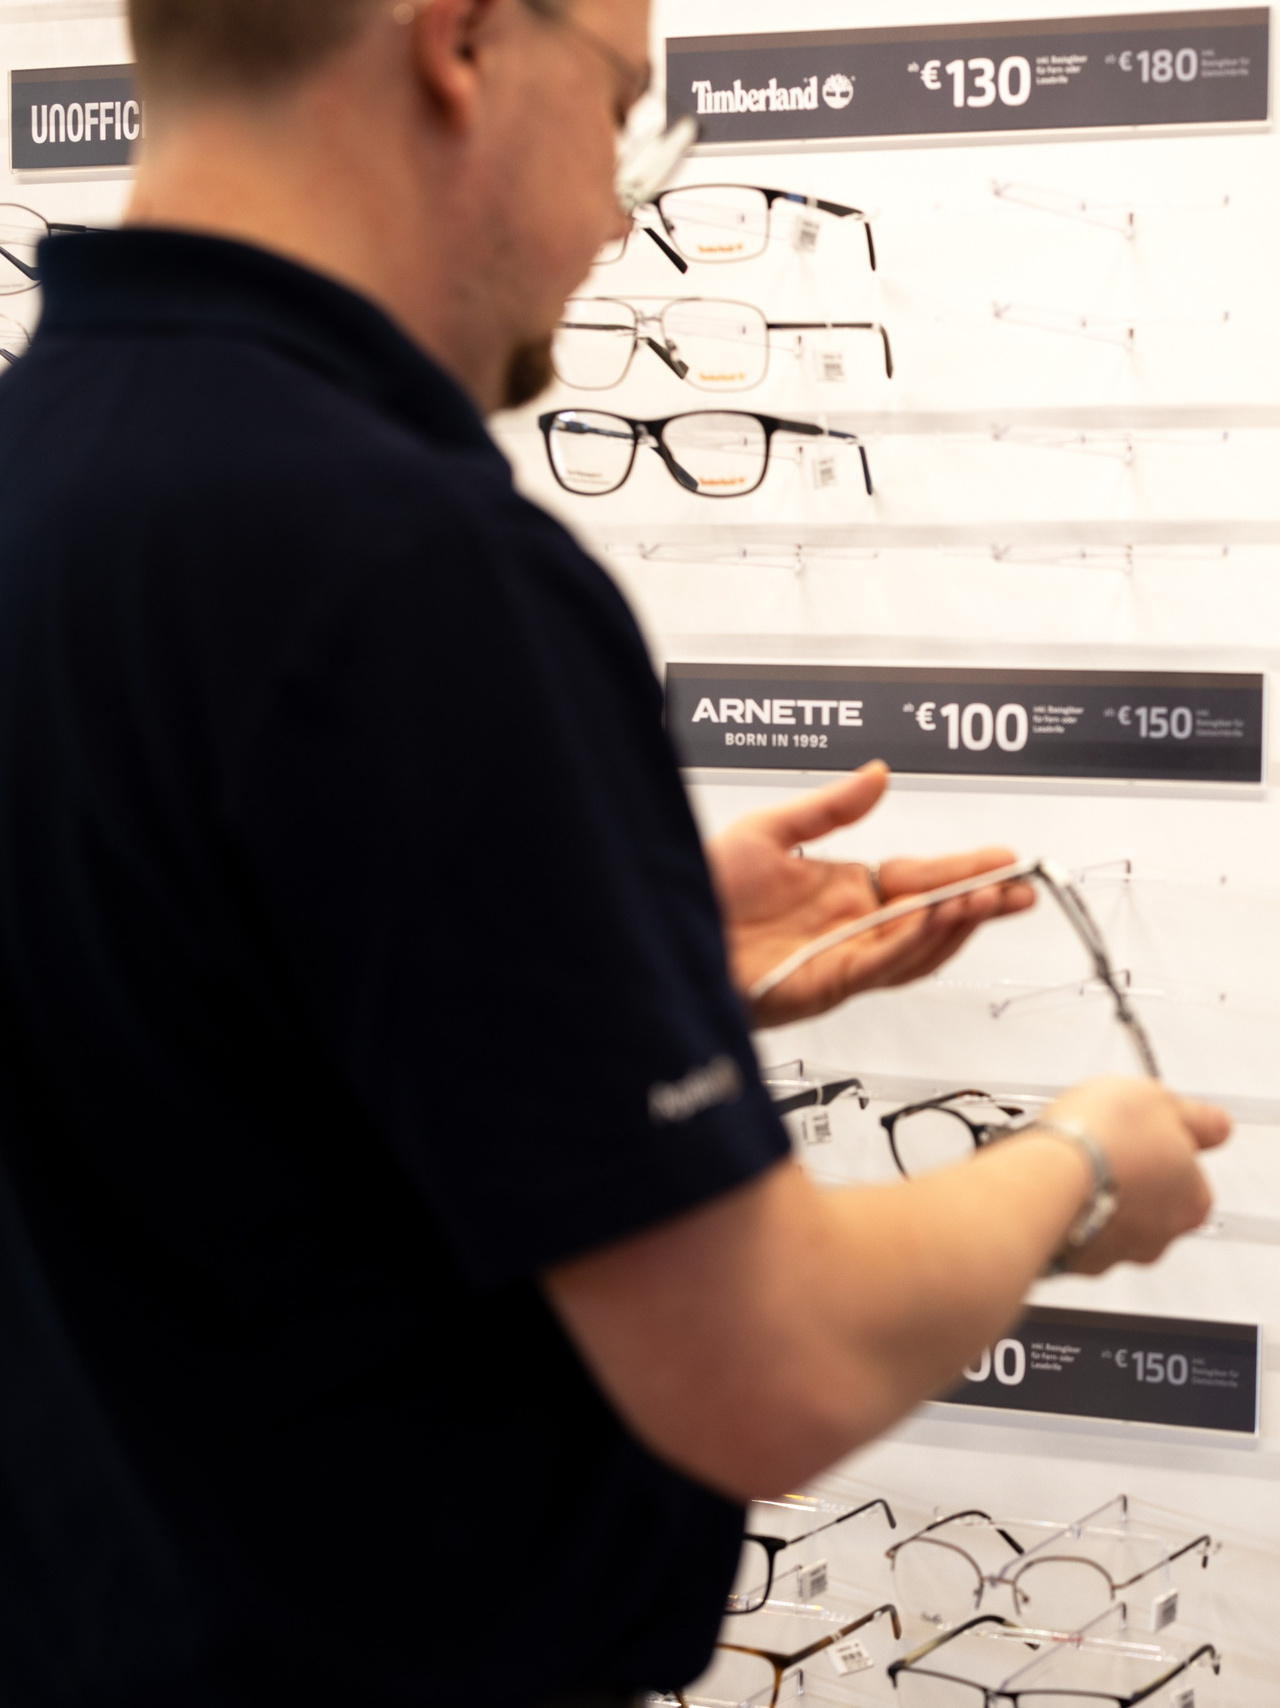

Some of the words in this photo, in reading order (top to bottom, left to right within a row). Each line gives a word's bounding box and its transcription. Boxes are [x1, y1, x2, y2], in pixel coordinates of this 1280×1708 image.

[920, 55, 1031, 108] €130
[1118, 47, 1199, 83] €180
[691, 75, 819, 114] Timberland
[691, 697, 863, 727] ARNETTE
[915, 702, 1028, 752] €100
[1117, 705, 1193, 740] €150
[725, 732, 767, 747] BORN
[772, 734, 788, 747] IN
[792, 734, 828, 748] 1992
[1114, 1349, 1189, 1386] €150
